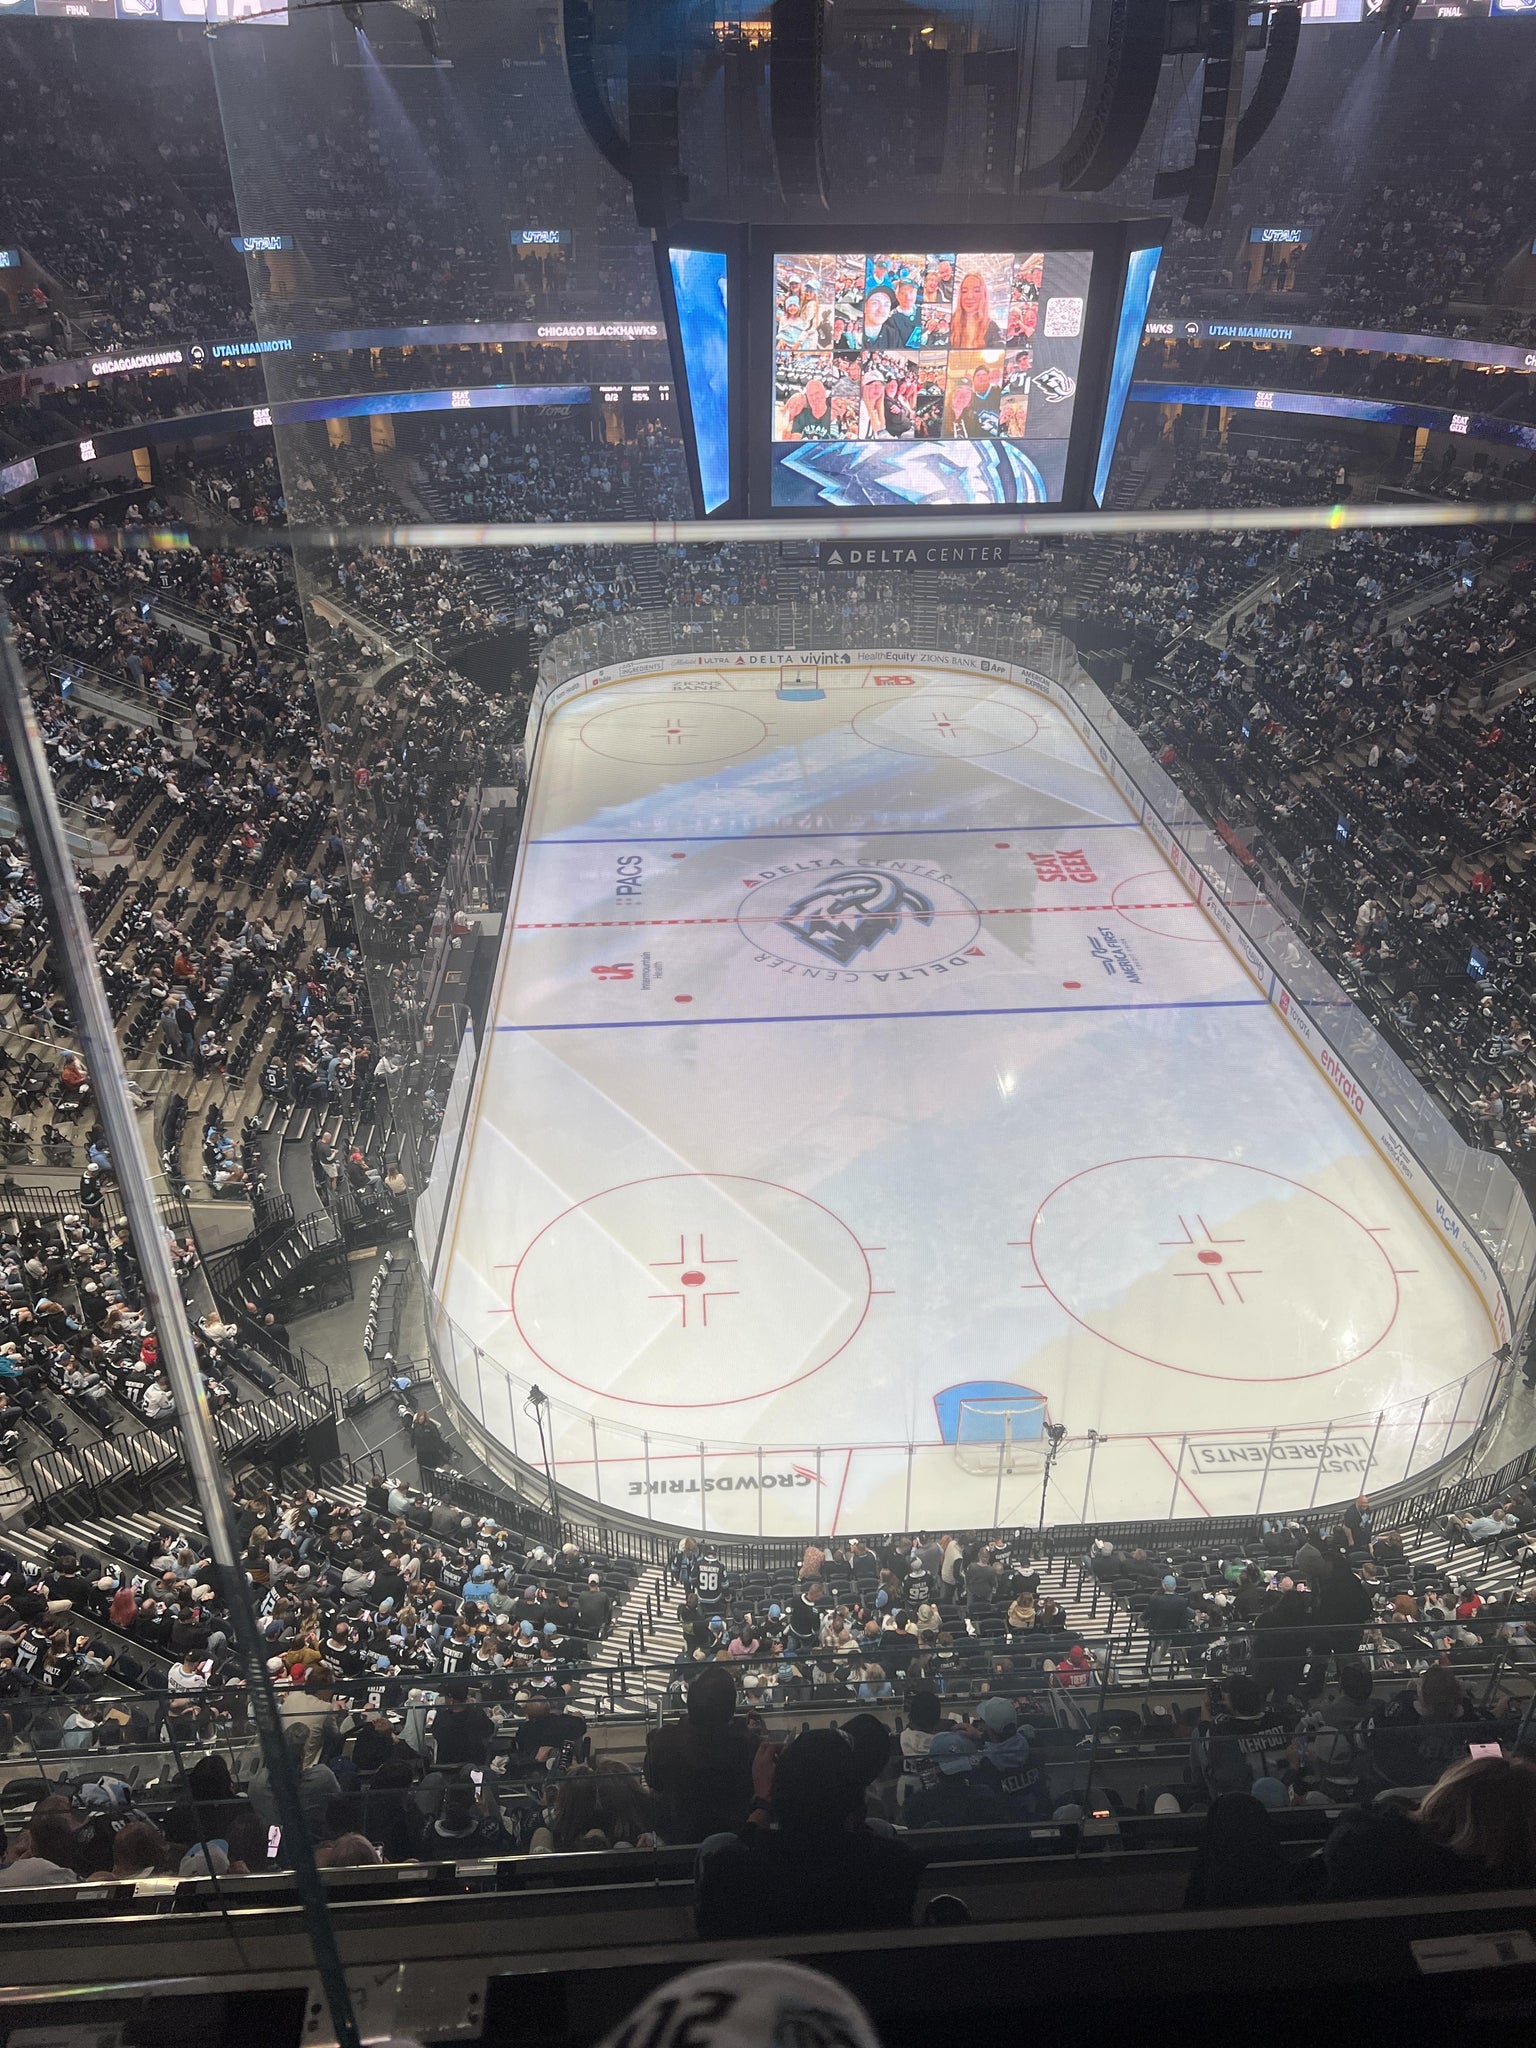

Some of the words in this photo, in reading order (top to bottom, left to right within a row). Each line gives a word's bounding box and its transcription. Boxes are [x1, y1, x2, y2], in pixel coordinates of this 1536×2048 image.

[66, 5, 90, 16] FINAL
[1437, 7, 1462, 17] FINAL
[243, 237, 281, 250] UTAH
[522, 231, 559, 243] UTAH
[1261, 229, 1301, 242] UTAH
[537, 326, 584, 337] CHICAGO
[586, 325, 658, 336] BLACKHAWKS
[1208, 325, 1236, 337] UTAH
[1237, 326, 1293, 339] MAMMOTH
[212, 346, 239, 358] UTAH
[240, 340, 292, 354] MAMMOTH
[850, 549, 918, 564] DELTA
[926, 547, 1002, 562] CENTER
[750, 655, 793, 664] DELTA
[857, 651, 915, 662] HealthEquity
[920, 653, 950, 664] ZIONS
[951, 656, 977, 668] BANK
[759, 858, 845, 880] DELTA
[857, 858, 953, 882] CENTER
[1026, 852, 1067, 882] SEAT
[1055, 848, 1098, 883] GEEK
[616, 855, 642, 896] PACS
[1097, 926, 1119, 950] FIRST
[753, 952, 860, 983] CENTER
[872, 956, 969, 982] DELTA
[1111, 949, 1143, 984] AMERICA
[1289, 1007, 1310, 1039] TOYOTA
[1321, 1050, 1365, 1115] entrata
[1201, 1443, 1362, 1463] INGREDIENTS
[628, 1474, 811, 1496] CROWDSTRIKE
[700, 1572, 718, 1590] 98
[909, 1587, 929, 1600] 92
[443, 1657, 458, 1673] 11
[1001, 1767, 1040, 1792] KELLER
